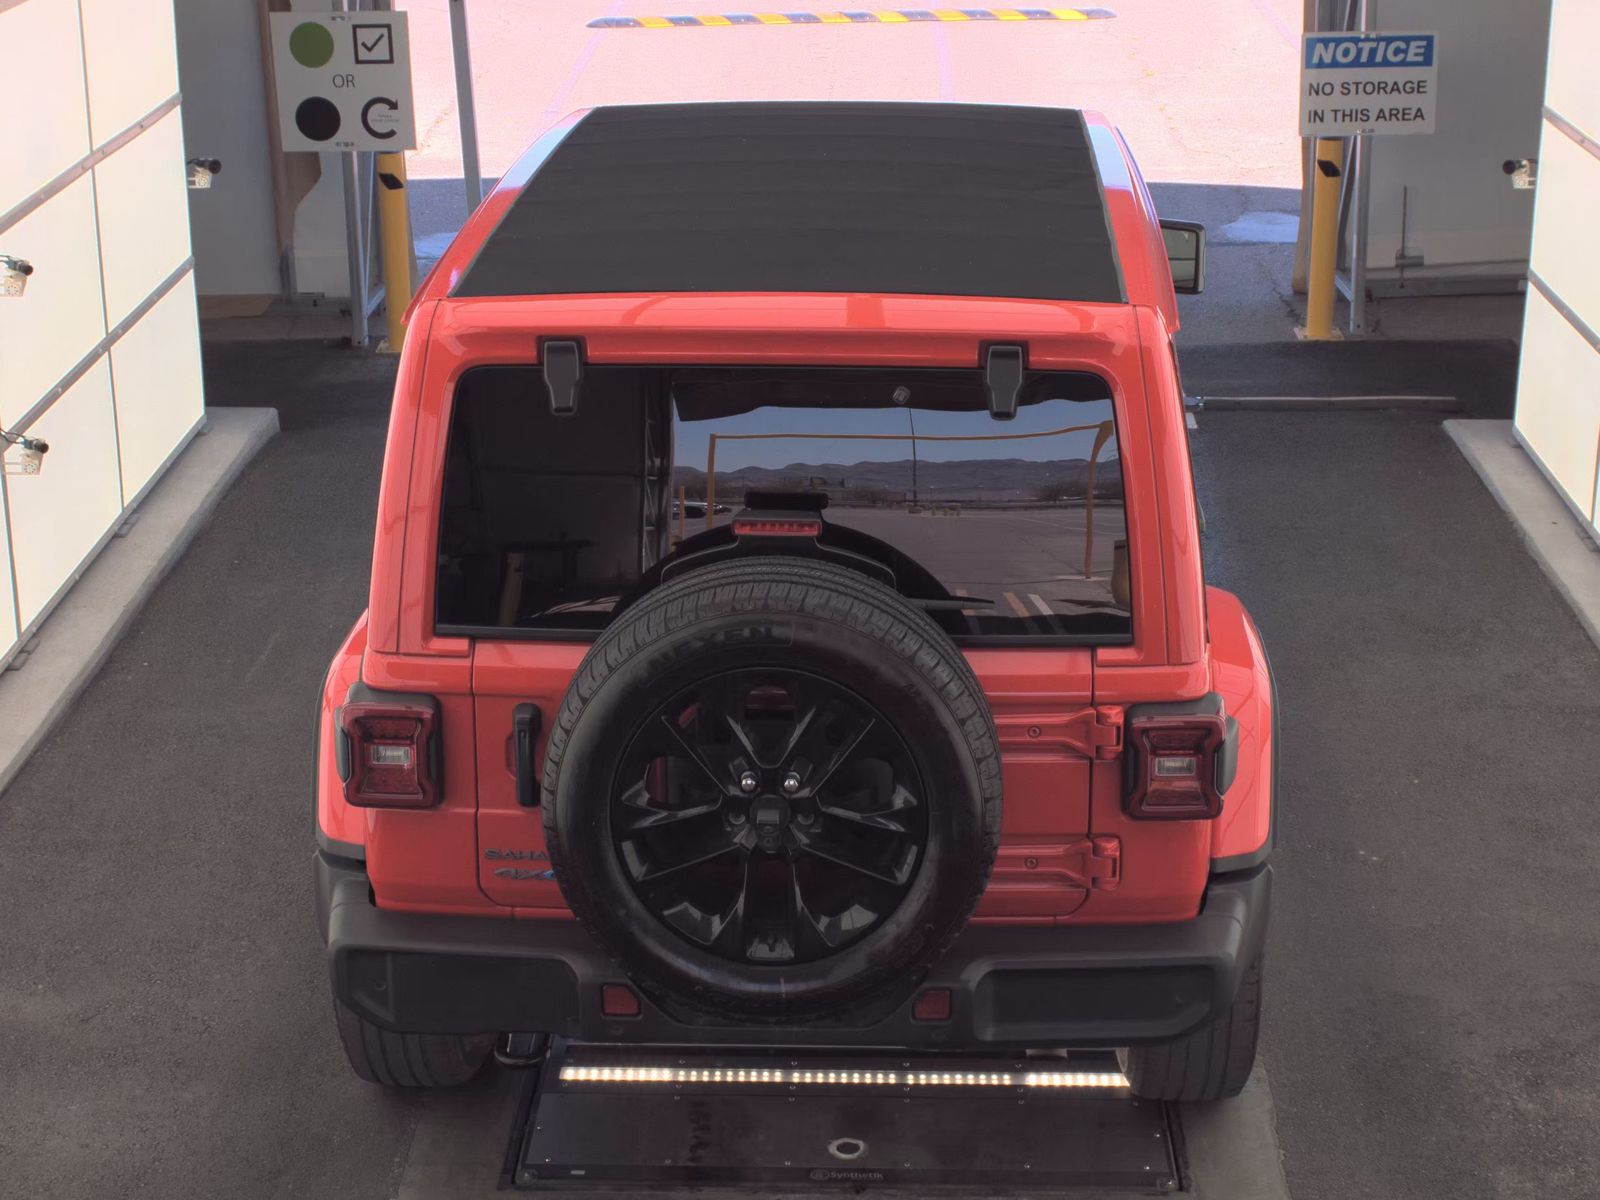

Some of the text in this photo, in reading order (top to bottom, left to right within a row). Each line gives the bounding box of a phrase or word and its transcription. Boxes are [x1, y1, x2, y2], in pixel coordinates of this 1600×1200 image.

[1312, 41, 1427, 64] NOTICE
[332, 74, 356, 88] OR
[1308, 80, 1428, 96] NO STORAGE
[1308, 107, 1425, 123] IN THIS AREA
